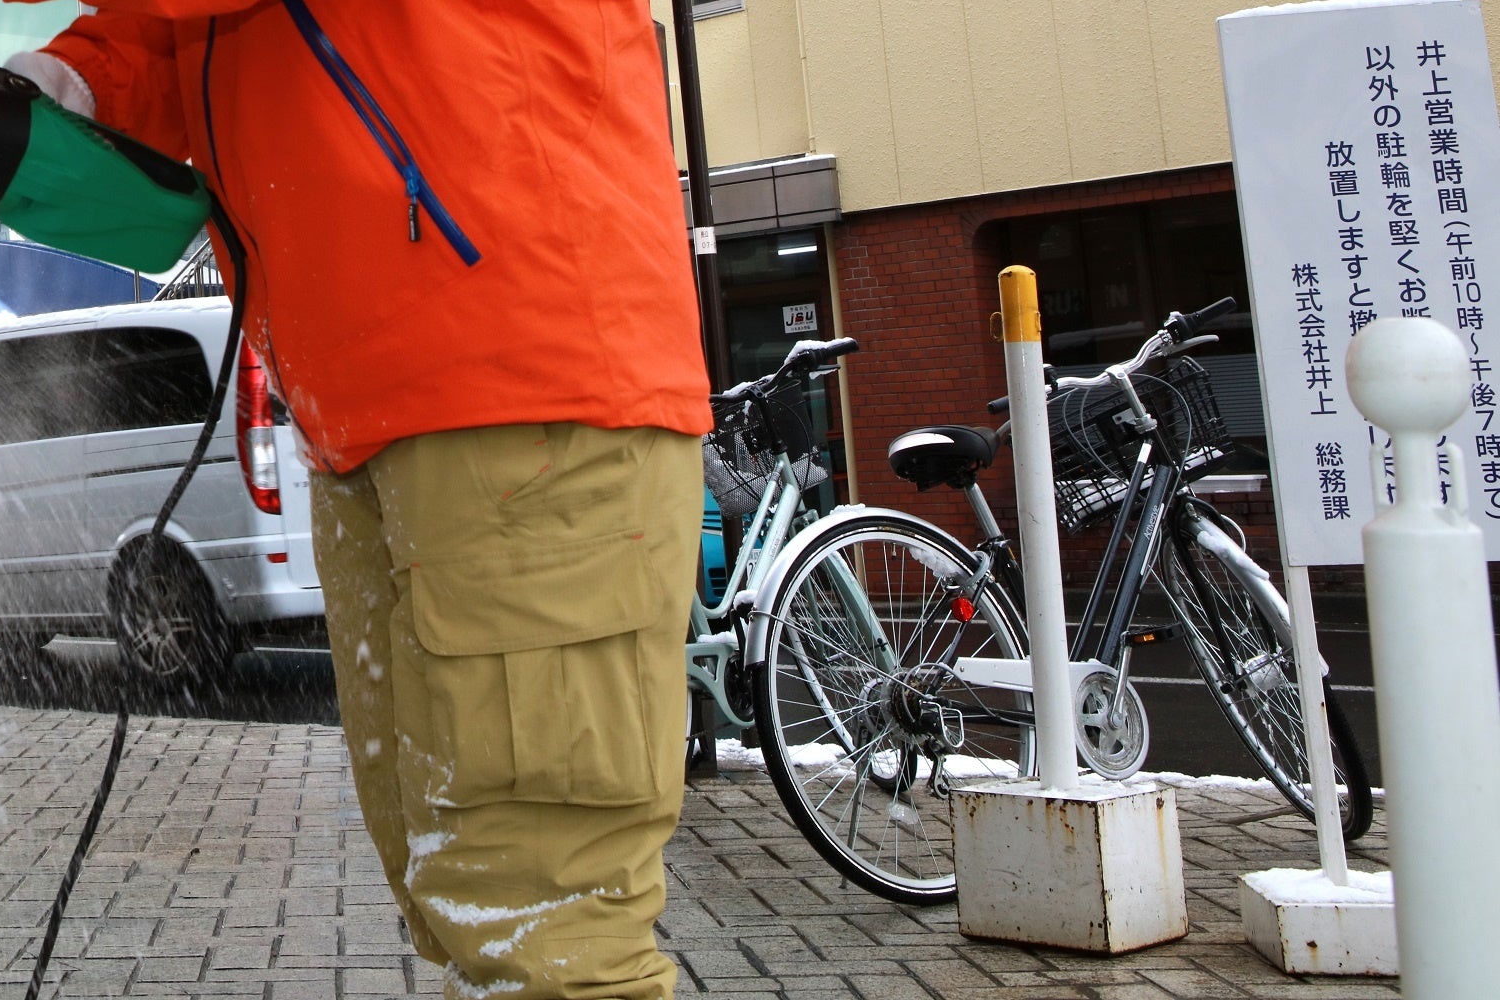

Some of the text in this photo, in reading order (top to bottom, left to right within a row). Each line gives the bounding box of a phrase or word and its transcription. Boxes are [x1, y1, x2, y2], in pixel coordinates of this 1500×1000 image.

[1291, 262, 1351, 521] 株式会社井上 総務課
